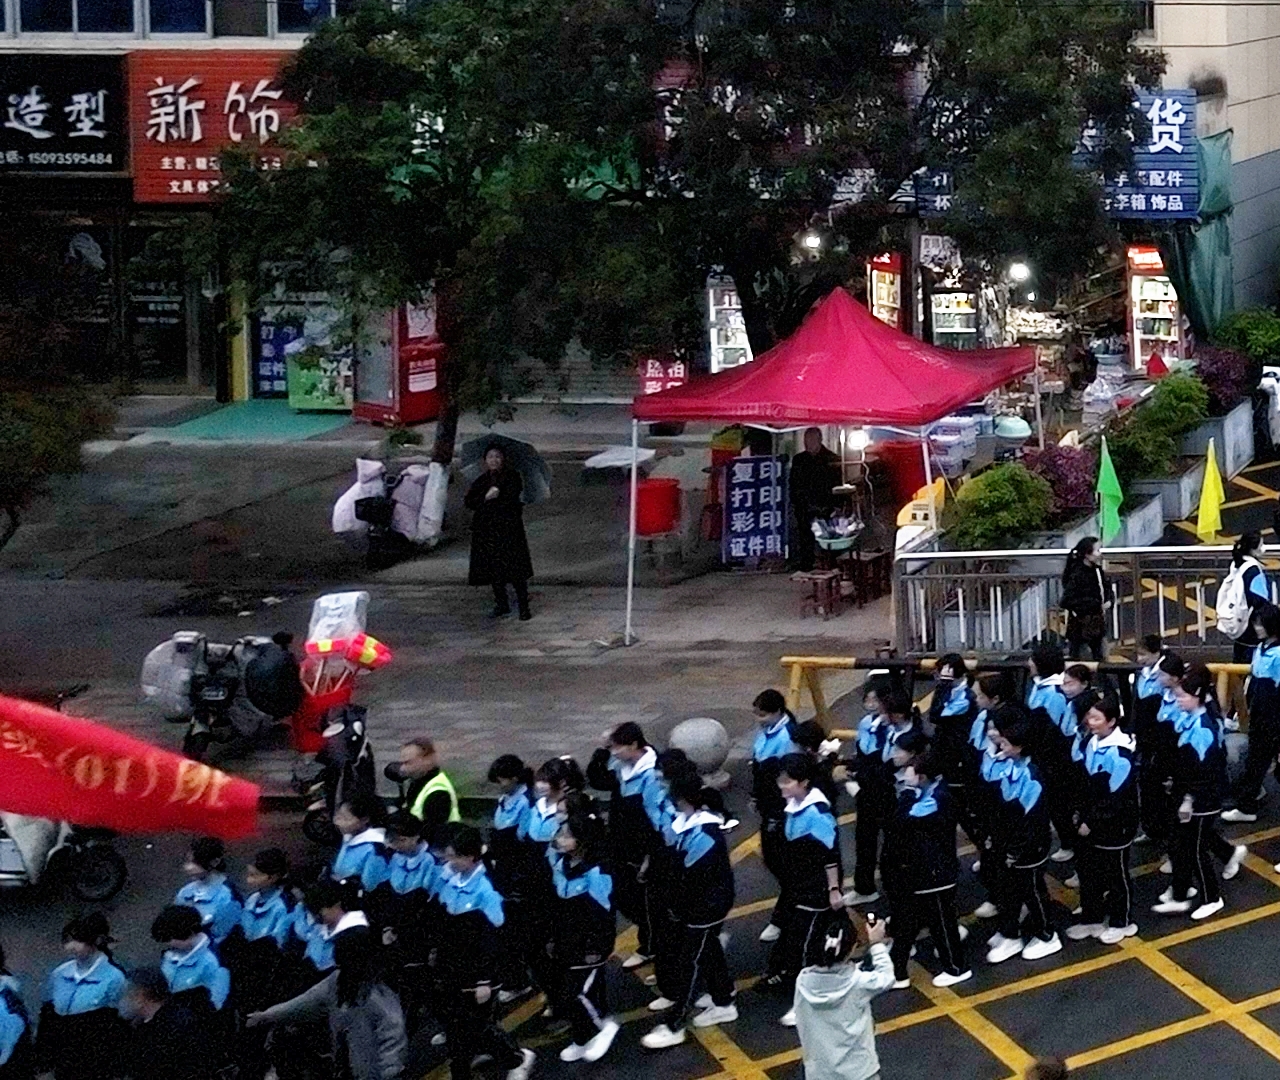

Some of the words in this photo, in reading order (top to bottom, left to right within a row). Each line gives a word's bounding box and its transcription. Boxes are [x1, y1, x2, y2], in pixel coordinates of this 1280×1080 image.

[5, 85, 108, 139] 造型
[146, 76, 283, 144] 新饰
[1148, 98, 1186, 154] 货
[1151, 194, 1183, 211] 饰品
[731, 461, 781, 483] 复印
[731, 486, 781, 508] 打印
[731, 511, 781, 533] 彩印
[730, 535, 782, 557] 证件照
